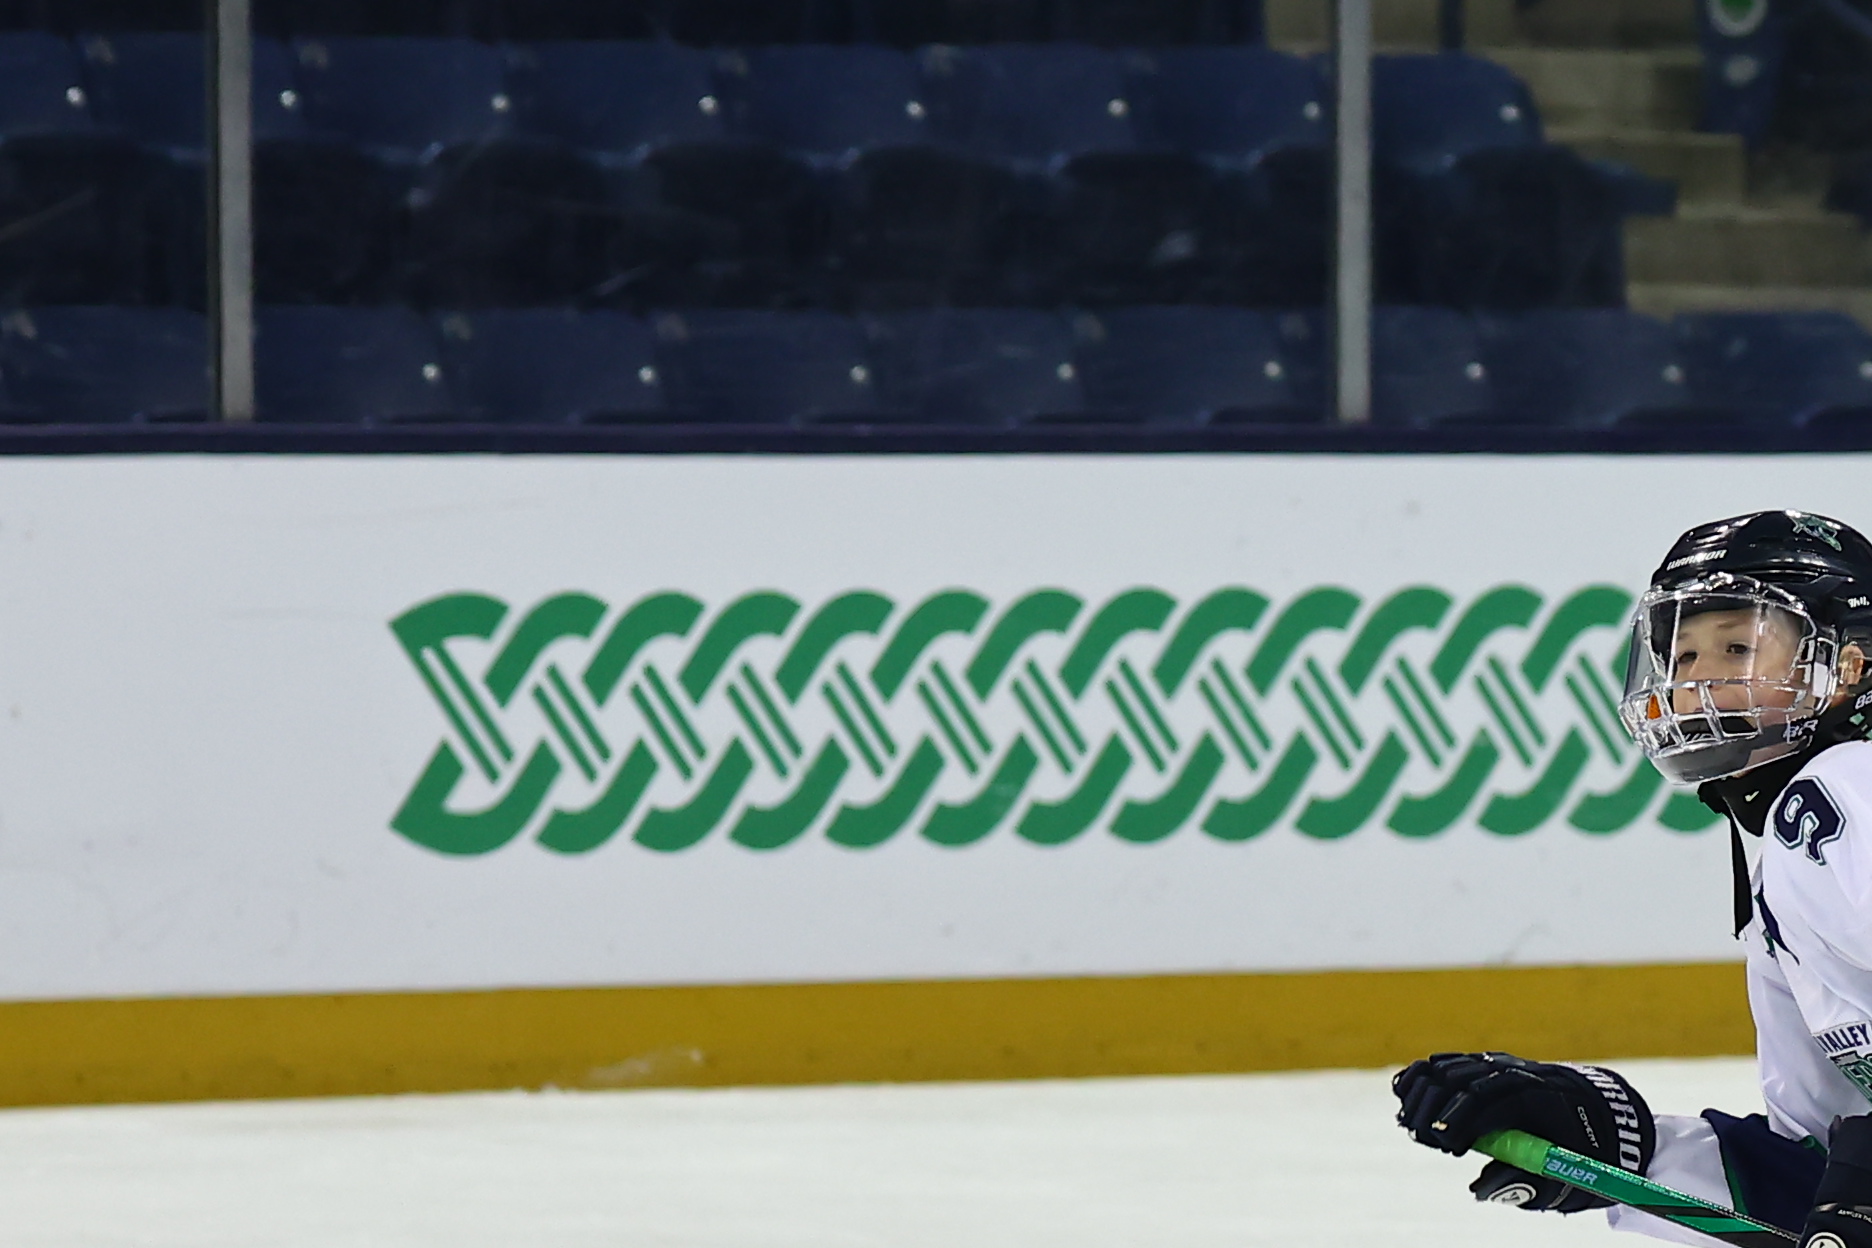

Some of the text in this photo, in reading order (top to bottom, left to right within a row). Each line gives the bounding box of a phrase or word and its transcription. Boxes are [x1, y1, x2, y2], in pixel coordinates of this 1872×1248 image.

[1773, 775, 1846, 866] 9
[1577, 1105, 1600, 1149] COVERT
[1546, 1158, 1598, 1186] AUER
